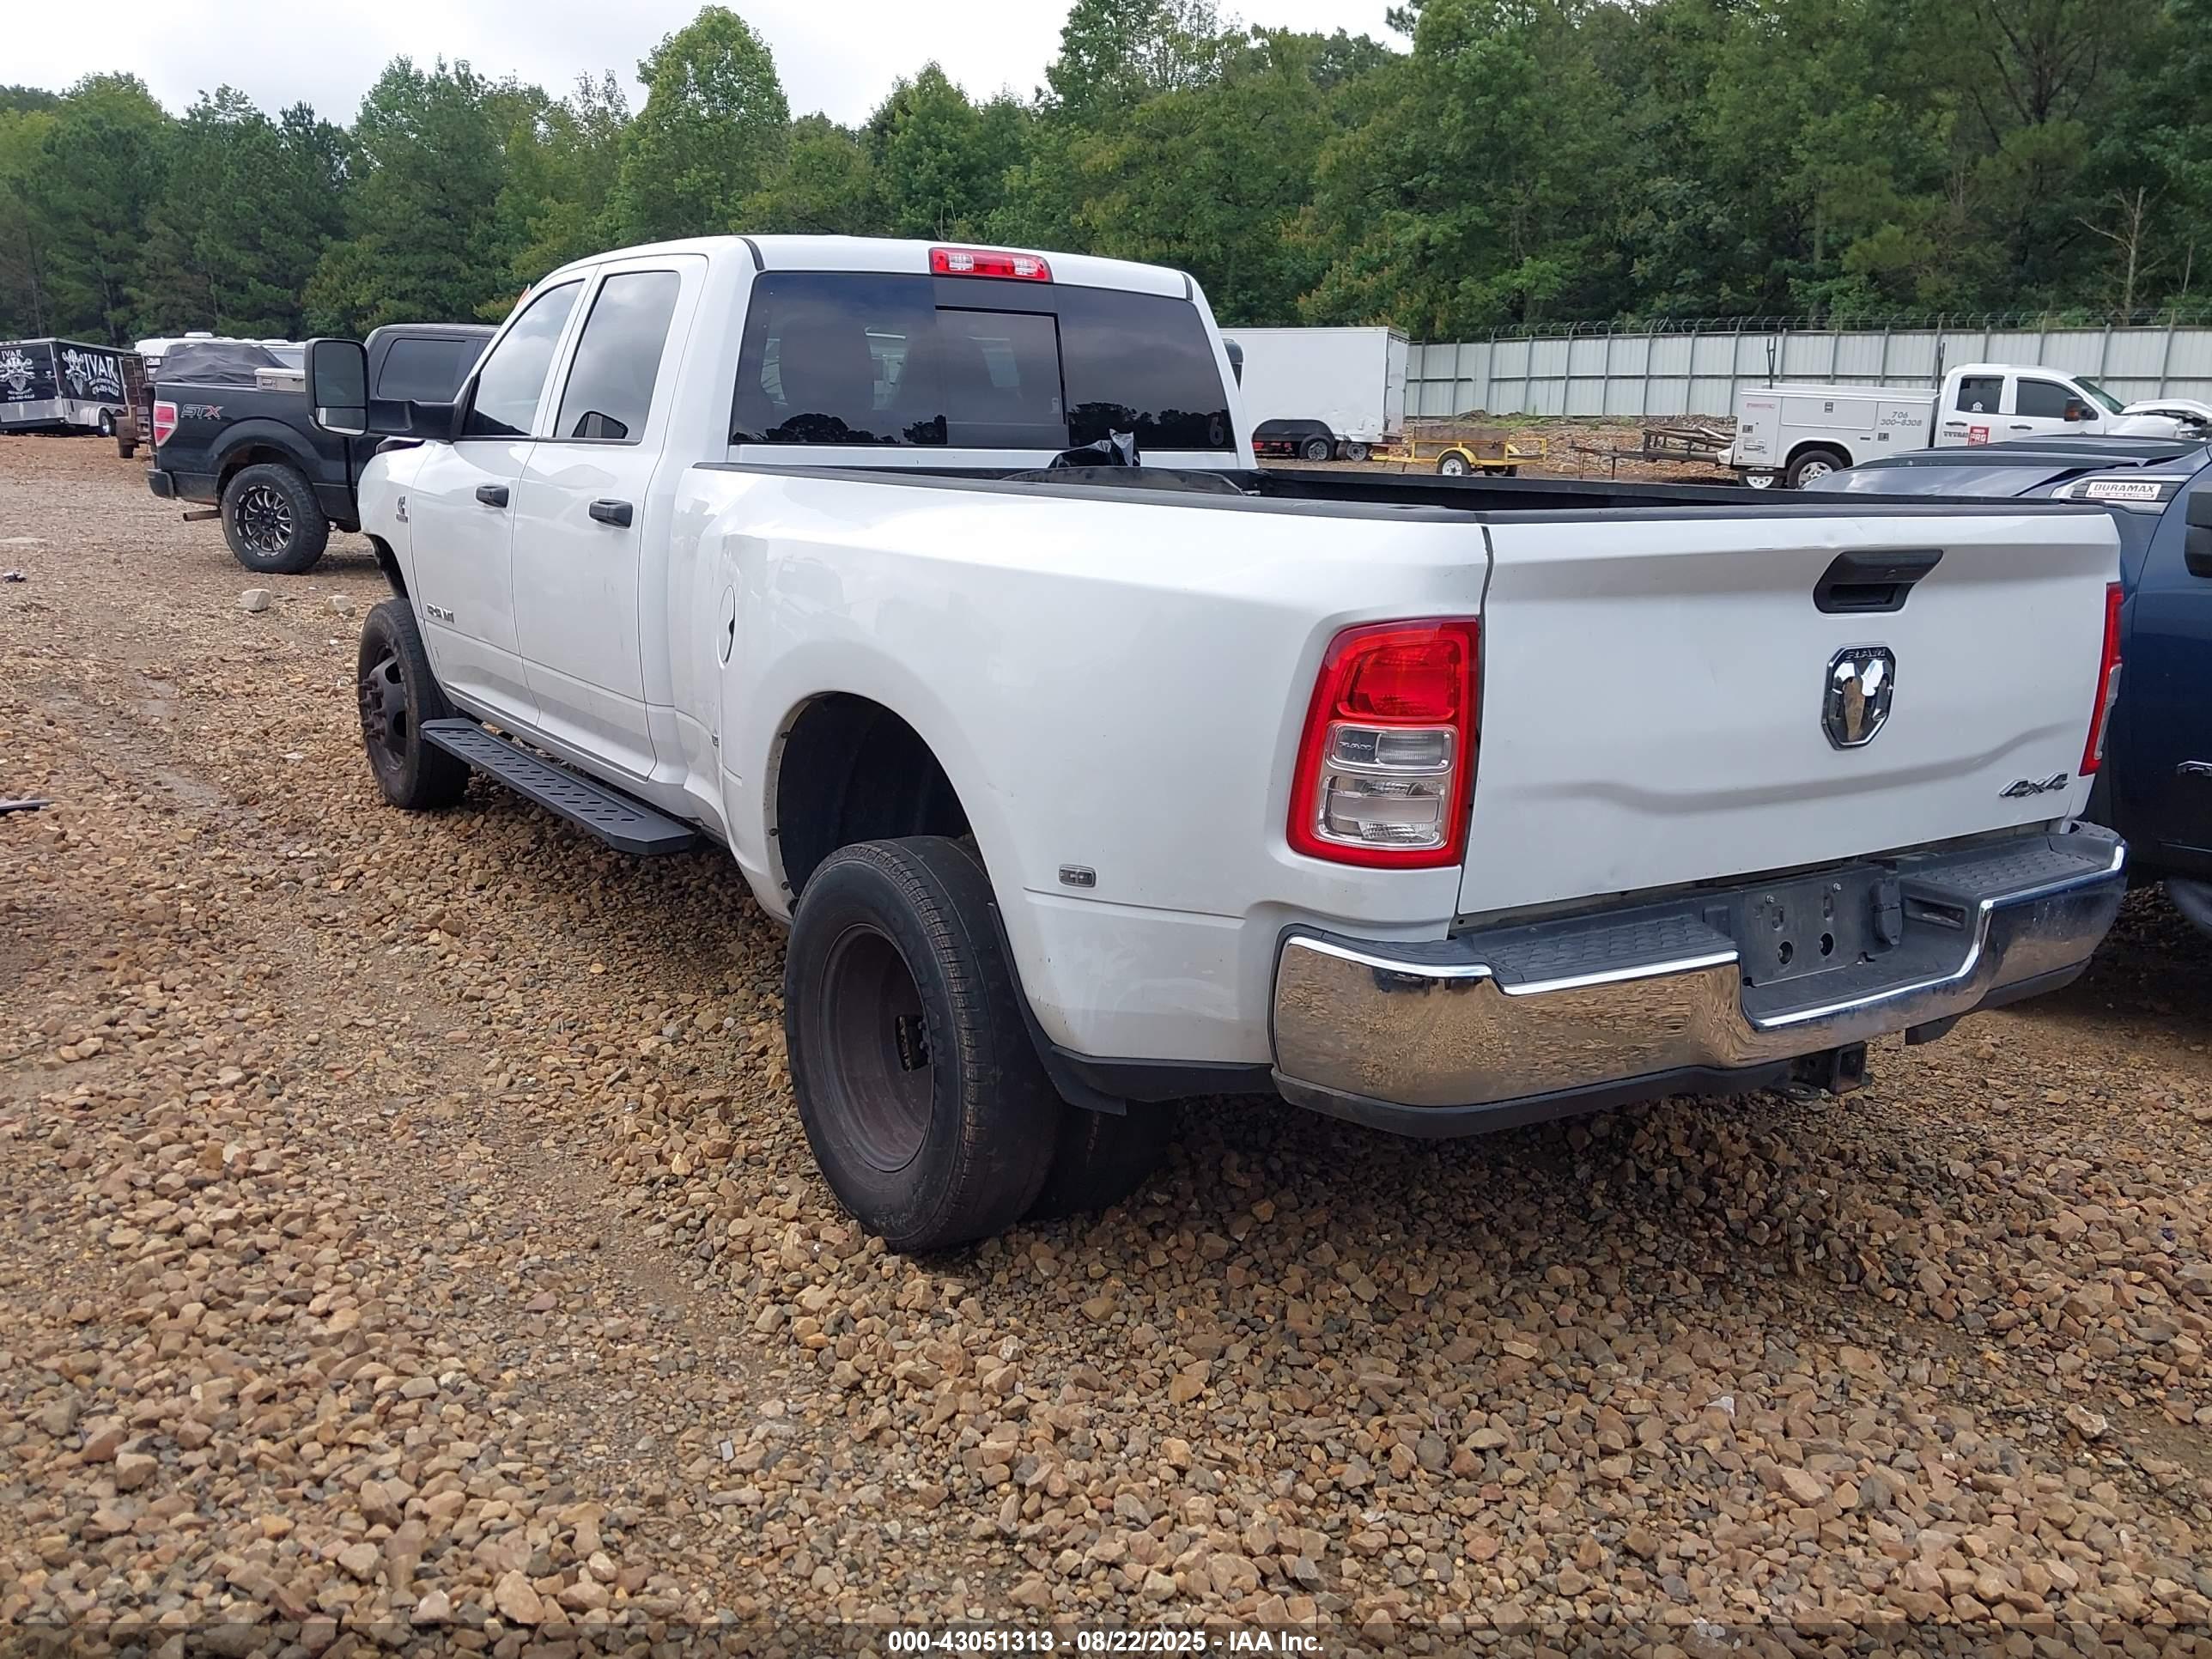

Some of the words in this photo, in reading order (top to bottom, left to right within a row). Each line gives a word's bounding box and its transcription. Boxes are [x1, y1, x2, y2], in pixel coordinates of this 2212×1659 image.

[1, 349, 24, 360] IVAR
[83, 353, 119, 383] IVAR
[181, 404, 224, 417] STX
[2094, 483, 2155, 493] DURAMAX
[426, 603, 454, 623] RAM
